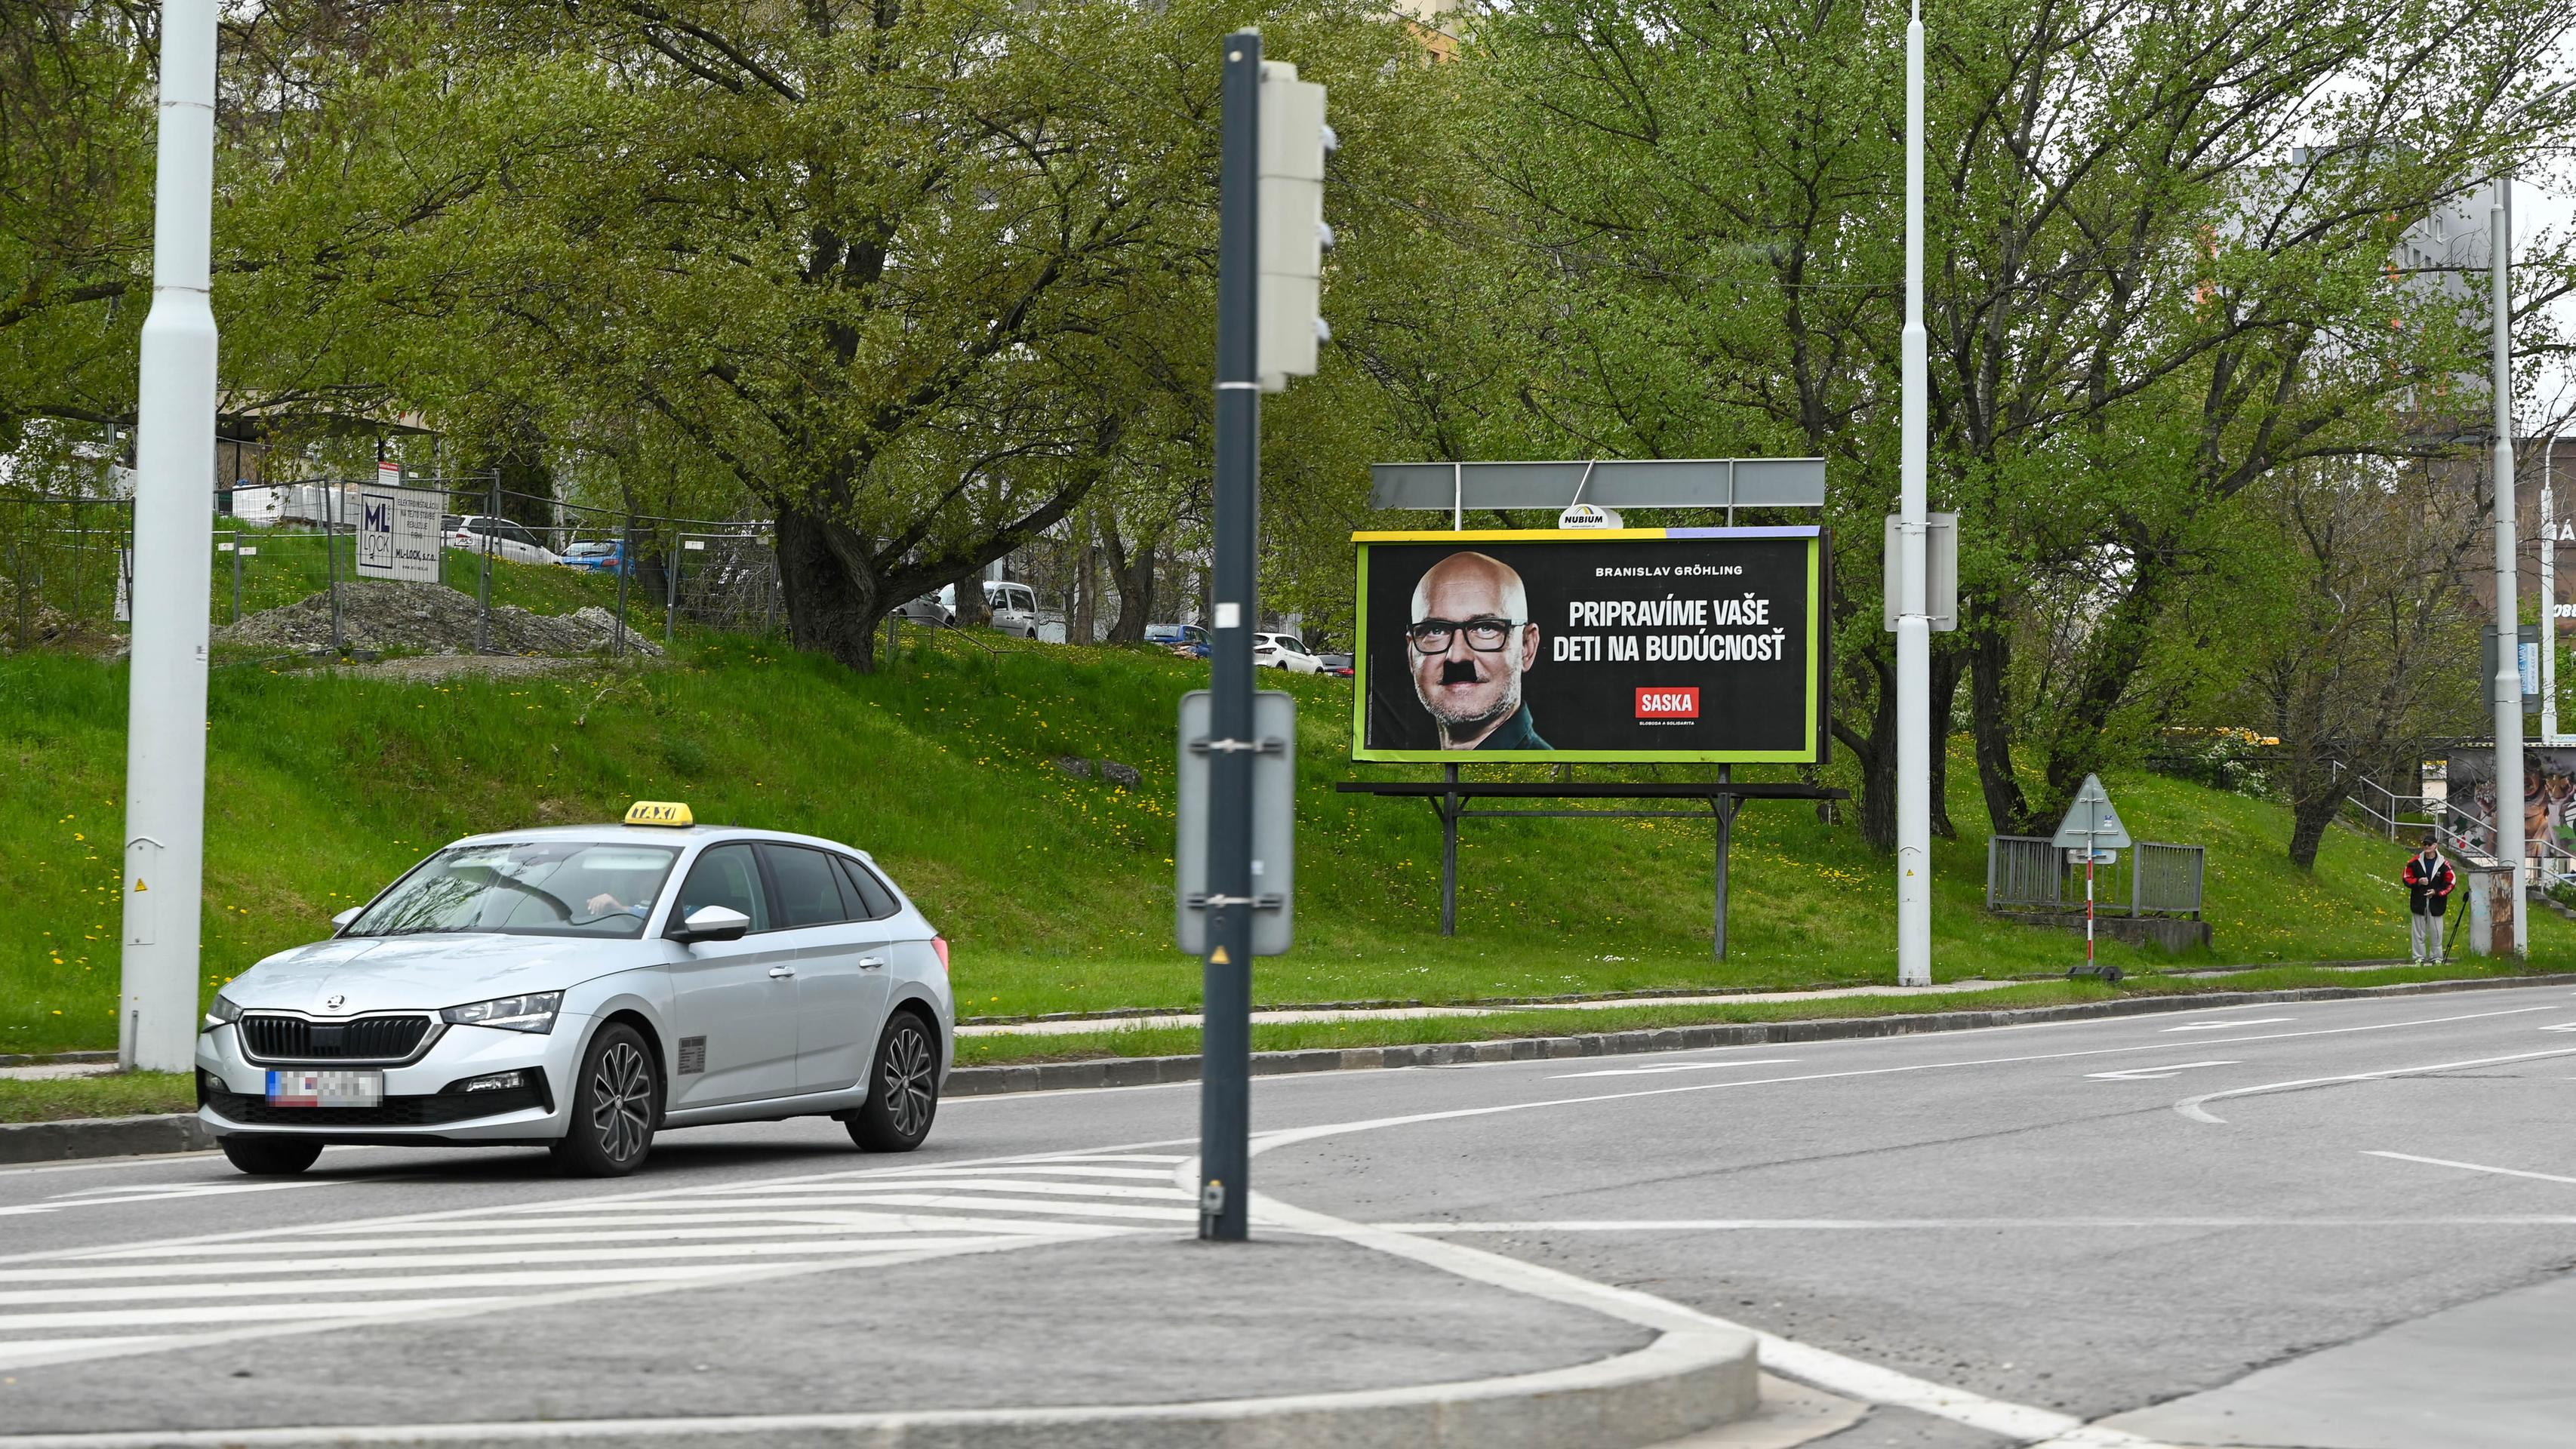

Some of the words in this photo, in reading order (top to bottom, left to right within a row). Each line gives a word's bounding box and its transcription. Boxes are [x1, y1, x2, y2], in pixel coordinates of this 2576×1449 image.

[365, 502, 390, 533] ML
[364, 534, 389, 555] LOCK
[1596, 567, 1671, 577] BRANISLAV
[1674, 565, 1743, 576] GRÖHLING
[1569, 593, 1708, 627] PRIPRAVÍME
[1713, 592, 1770, 626] VAŠE
[1553, 635, 1601, 662] DETI
[1608, 635, 1640, 661] NA
[1645, 627, 1786, 661] BUDÚCNOSŤ
[1642, 694, 1693, 712] SASKA
[632, 806, 677, 820] TAXI
